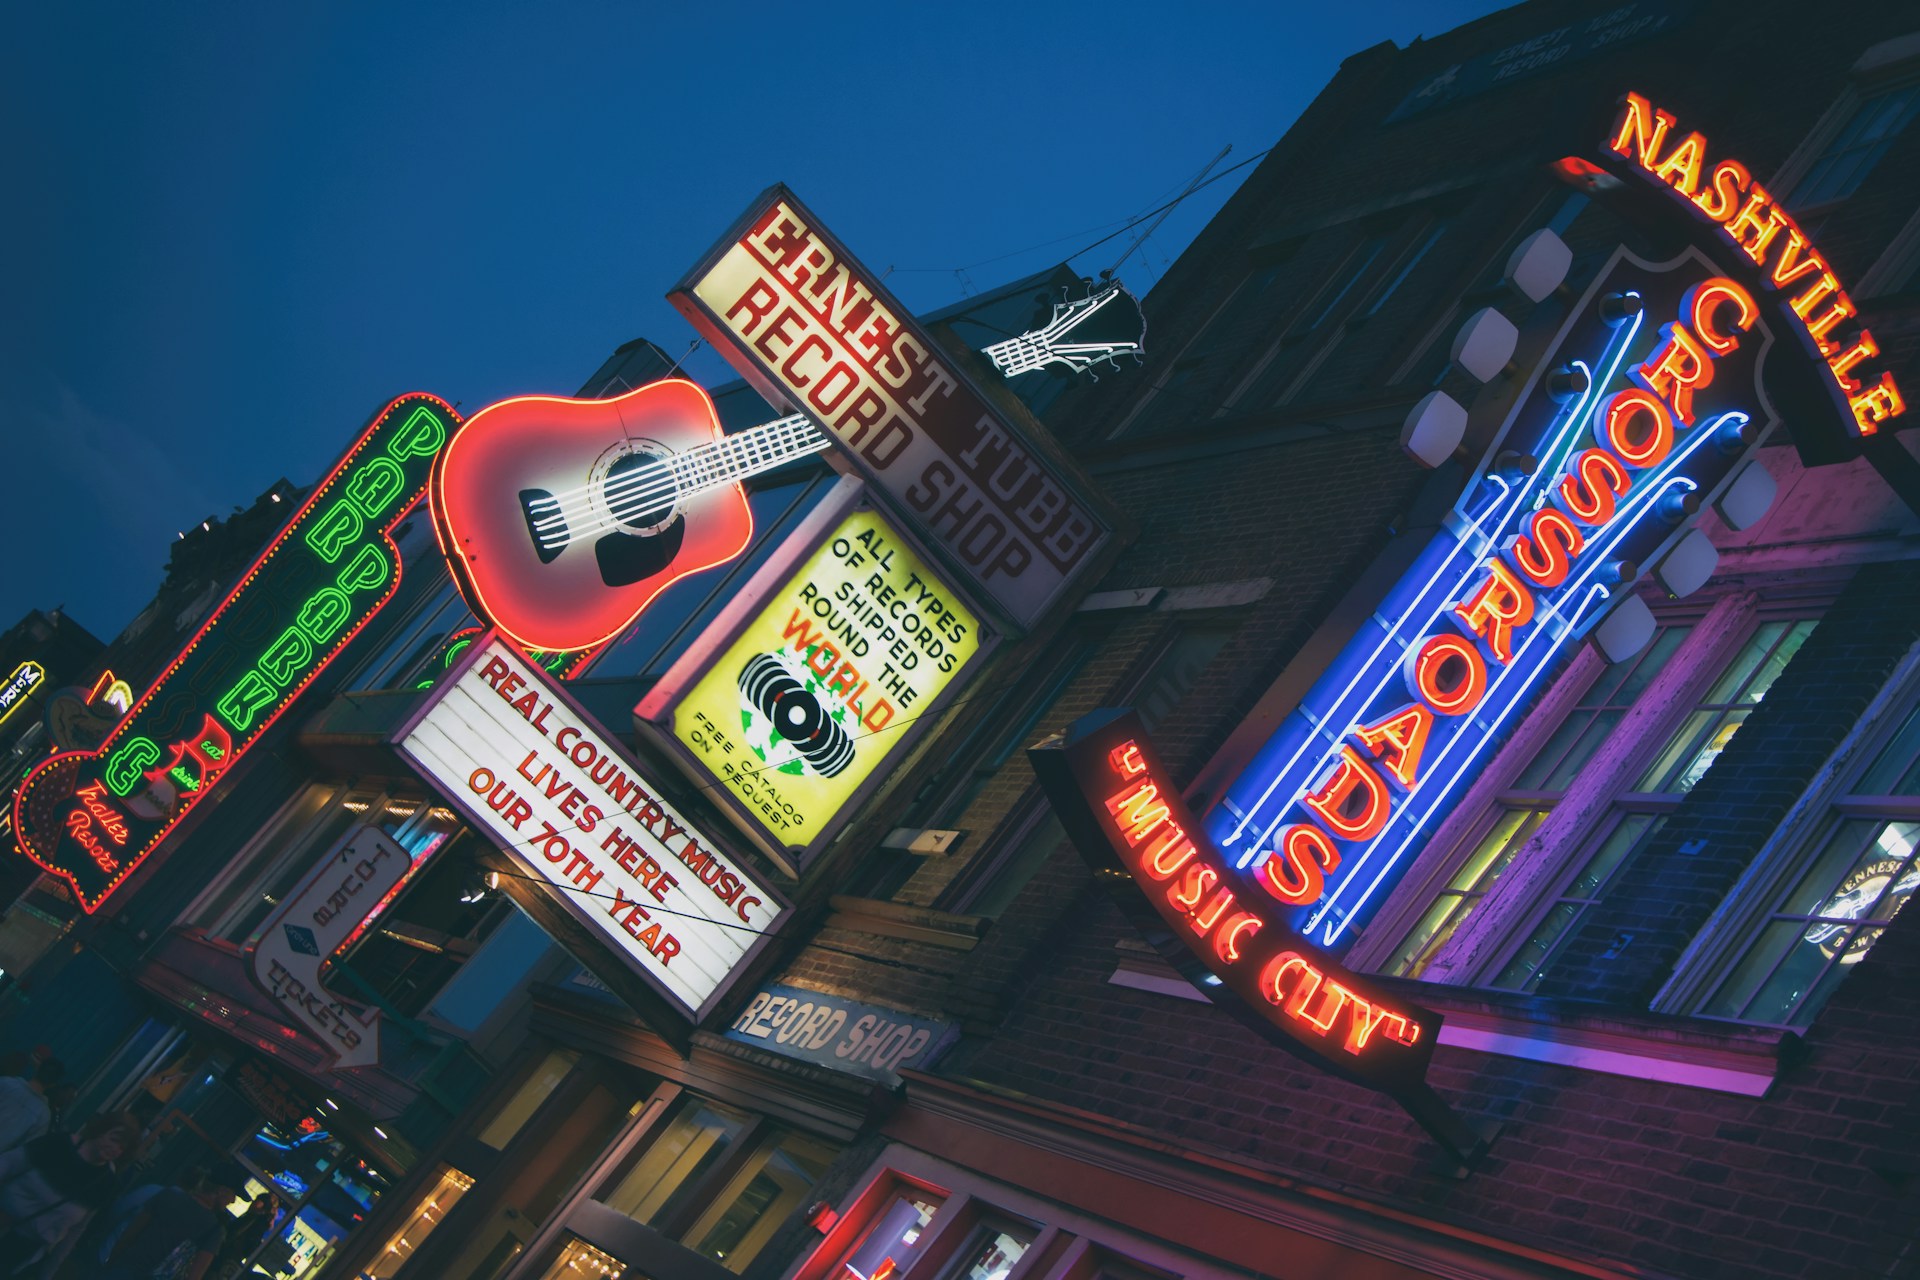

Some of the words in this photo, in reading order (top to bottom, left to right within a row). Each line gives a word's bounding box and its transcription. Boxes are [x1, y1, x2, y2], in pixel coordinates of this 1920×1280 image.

[1605, 91, 1907, 438] NASHVILLE
[725, 276, 914, 472] RECORD
[904, 460, 1033, 581] SHOP
[747, 202, 957, 417] ERNEST
[960, 413, 1098, 562] TUBB
[217, 544, 389, 732] PARK
[799, 581, 870, 659] ROUND
[877, 662, 918, 709] THE
[831, 537, 867, 571] OF
[864, 575, 959, 674] RECORDS
[834, 580, 919, 671] SHIPPED
[855, 527, 893, 574] ALL
[901, 572, 968, 645] TYPES
[1255, 275, 1761, 906] CROSSROADS
[781, 607, 897, 733] WORLD
[478, 655, 553, 736] REAL
[555, 726, 688, 845] COUNTRY
[678, 838, 763, 923] MUSIC
[516, 749, 604, 834] LIVES
[600, 826, 679, 904] HERE
[690, 730, 713, 755] ON
[722, 762, 792, 833] REQUEST
[692, 711, 735, 755] FREE
[741, 760, 805, 827] CATALOG
[66, 808, 119, 874] Resort
[312, 842, 392, 928] TOURS
[468, 766, 533, 832] OUR
[527, 819, 605, 894] 70TH
[607, 888, 682, 968] YEAR
[266, 957, 363, 1051] TICKETS
[730, 991, 848, 1051] RECORD
[834, 1014, 932, 1071] SHOP
